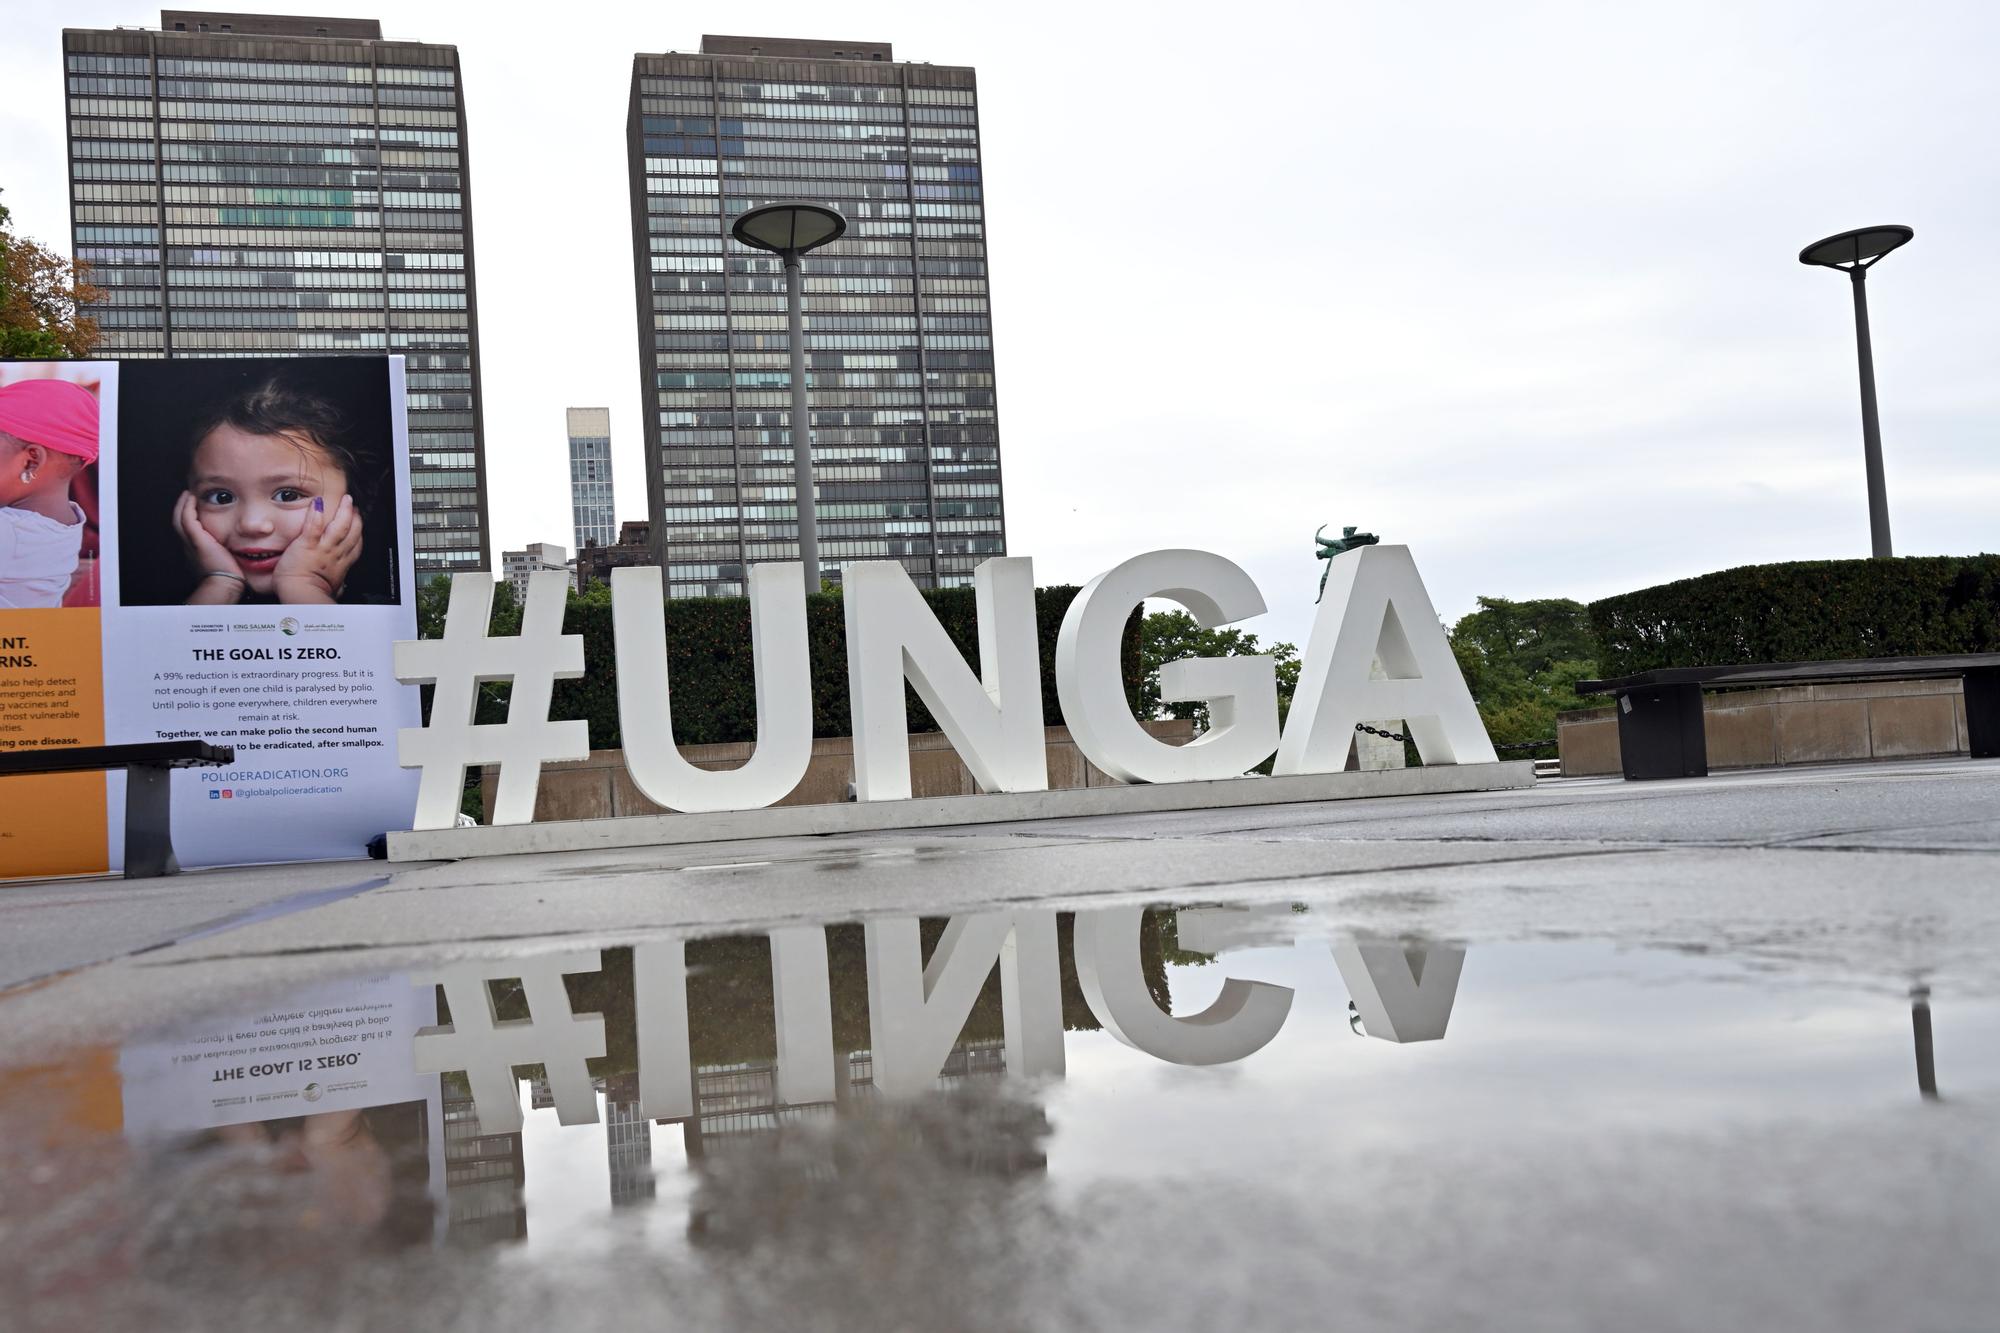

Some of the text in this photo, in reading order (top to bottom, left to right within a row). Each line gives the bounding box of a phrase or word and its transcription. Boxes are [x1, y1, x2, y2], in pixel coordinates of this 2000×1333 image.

[193, 647, 341, 661] THE GOAL IS ZERO.
[163, 672, 184, 680] 99%
[186, 671, 229, 680] reduction
[241, 670, 299, 680] extraordinary
[301, 670, 340, 680] progress.
[343, 669, 357, 677] But
[359, 669, 365, 677] it
[367, 669, 374, 677] is
[1, 677, 76, 688] also help detect
[394, 544, 1500, 830] #UNGA
[58, 688, 76, 697] and
[155, 687, 171, 695] not
[173, 686, 208, 696] enough
[210, 685, 217, 693] if
[219, 686, 240, 694] even
[262, 684, 283, 693] child
[286, 684, 293, 692] is
[295, 683, 336, 694] paralysed
[338, 683, 348, 693] by
[8, 700, 48, 709] vaccines
[51, 699, 69, 708] and
[152, 701, 174, 709] Until
[177, 700, 200, 711] polio
[213, 701, 236, 710] gone
[238, 698, 291, 709] everywhere,
[293, 698, 328, 707] children
[329, 698, 378, 707] everywhere
[3, 711, 80, 721] most vulnerable
[238, 713, 269, 721] remain
[282, 712, 299, 721] risk.
[156, 729, 202, 740] Together,
[220, 729, 237, 737] can
[240, 728, 266, 736] make
[268, 727, 292, 737] polio
[294, 726, 310, 735] the
[312, 725, 344, 734] second
[346, 725, 378, 733] human
[18, 738, 38, 746] one
[41, 736, 80, 745] disease.
[249, 742, 262, 750] be
[263, 740, 315, 750] eradicated,
[317, 739, 340, 748] after
[342, 739, 384, 749] smallpox.
[201, 768, 349, 782] POLIOERADICATION.ORG
[235, 785, 343, 798] @globalpolioeradication
